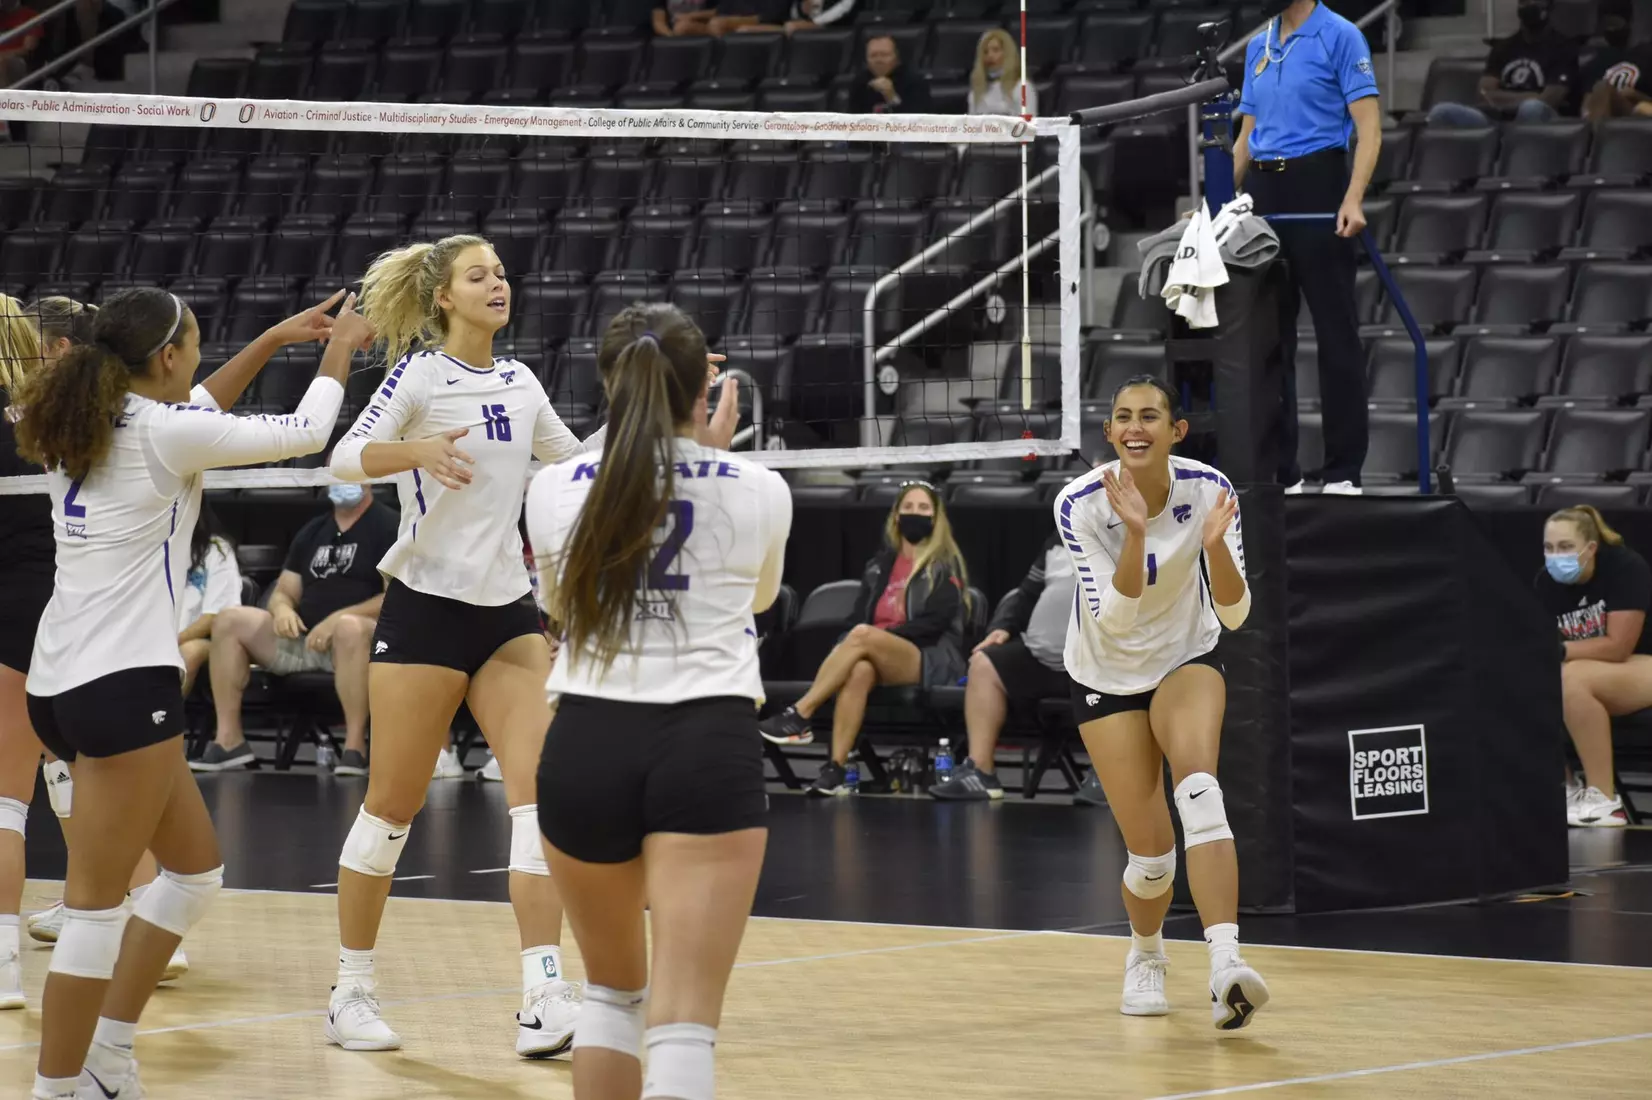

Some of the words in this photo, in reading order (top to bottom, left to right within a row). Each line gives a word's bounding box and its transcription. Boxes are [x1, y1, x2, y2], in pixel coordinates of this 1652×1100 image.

[32, 100, 60, 112] Public
[62, 101, 130, 115] Administration
[137, 104, 164, 116] Social
[166, 105, 190, 116] Work
[264, 109, 298, 120] Aviation
[306, 110, 341, 121] Criminal
[342, 111, 372, 122] Justice
[380, 112, 447, 126] Multidisciplinary
[449, 113, 477, 124] Studies
[484, 114, 530, 127] Emergency
[530, 116, 582, 129] Management
[588, 116, 615, 130] College
[618, 117, 627, 127] of
[628, 118, 651, 128] Public
[653, 118, 676, 128] Affairs
[679, 118, 685, 128] &
[687, 118, 731, 132] Community
[732, 119, 759, 130] Service
[764, 120, 809, 133] Gerontology
[849, 122, 879, 132] Scholars
[885, 122, 906, 133] Public
[907, 123, 957, 133] Administration
[481, 404, 512, 441] 16
[1354, 746, 1422, 768] SPORT
[1353, 764, 1423, 784] FLOORS
[1354, 779, 1424, 798] LEASING
